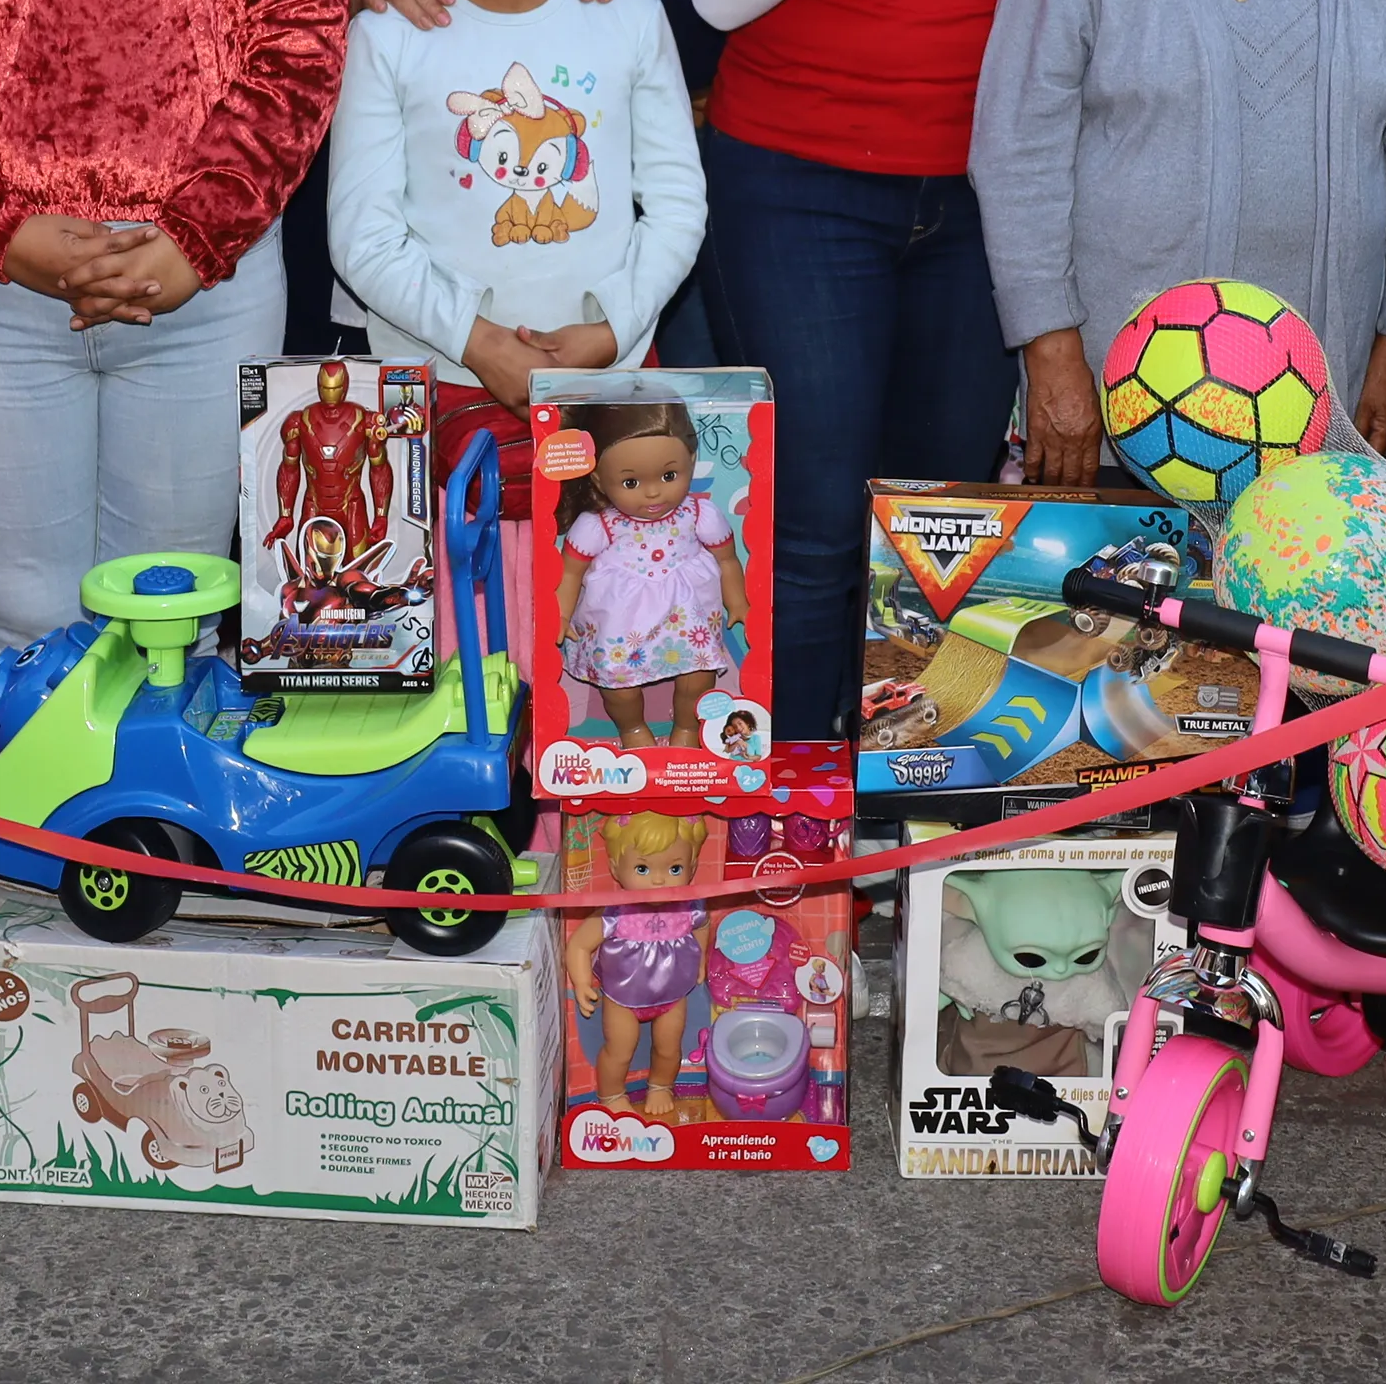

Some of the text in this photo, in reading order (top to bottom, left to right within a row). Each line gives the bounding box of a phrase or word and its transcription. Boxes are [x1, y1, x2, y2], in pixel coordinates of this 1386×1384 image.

[890, 516, 1003, 538] MONSTER
[921, 535, 971, 553] JAM
[279, 675, 380, 687] TITAN HERO SERIES
[1183, 719, 1210, 731] TRUE
[554, 754, 591, 767] little
[666, 762, 688, 770] Sweet
[552, 766, 634, 785] MOMMY
[743, 773, 758, 785] 2+
[887, 757, 955, 787] Digger
[655, 777, 688, 786] Mignonne
[674, 784, 691, 792] Doce
[974, 849, 1014, 862] sonido,
[1018, 850, 1054, 860] aroma
[1058, 850, 1067, 863] y
[1070, 850, 1084, 860] un
[1088, 848, 1127, 860] morral
[1130, 848, 1143, 860] de
[1148, 850, 1174, 862] rega
[720, 919, 762, 938] PRESIONA
[738, 934, 750, 943] EL
[731, 938, 766, 956] ASIENTO
[5, 978, 16, 989] 3
[331, 1018, 470, 1044] CARRITO
[316, 1050, 486, 1077] MONTABLE
[1070, 1087, 1094, 1105] dijes
[286, 1091, 513, 1127] Rolling Animal
[584, 1122, 620, 1137] little
[909, 1111, 1017, 1134] WARS
[328, 1133, 442, 1147] PRODUCTO NO TOXICO
[581, 1135, 661, 1153] MOMMY
[701, 1134, 776, 1148] Aprendiendo
[328, 1143, 369, 1154] SEGURO
[708, 1148, 772, 1160] a ir al baño
[328, 1154, 412, 1166] COLORES FIRMES
[907, 1147, 1098, 1176] MANDALORIAN
[328, 1164, 375, 1174] DURABLE
[35, 1169, 41, 1181] 1
[46, 1170, 89, 1184] PIEZA
[466, 1176, 488, 1188] MX
[465, 1190, 513, 1200] HECHO EN
[465, 1199, 513, 1211] MÉXICO
